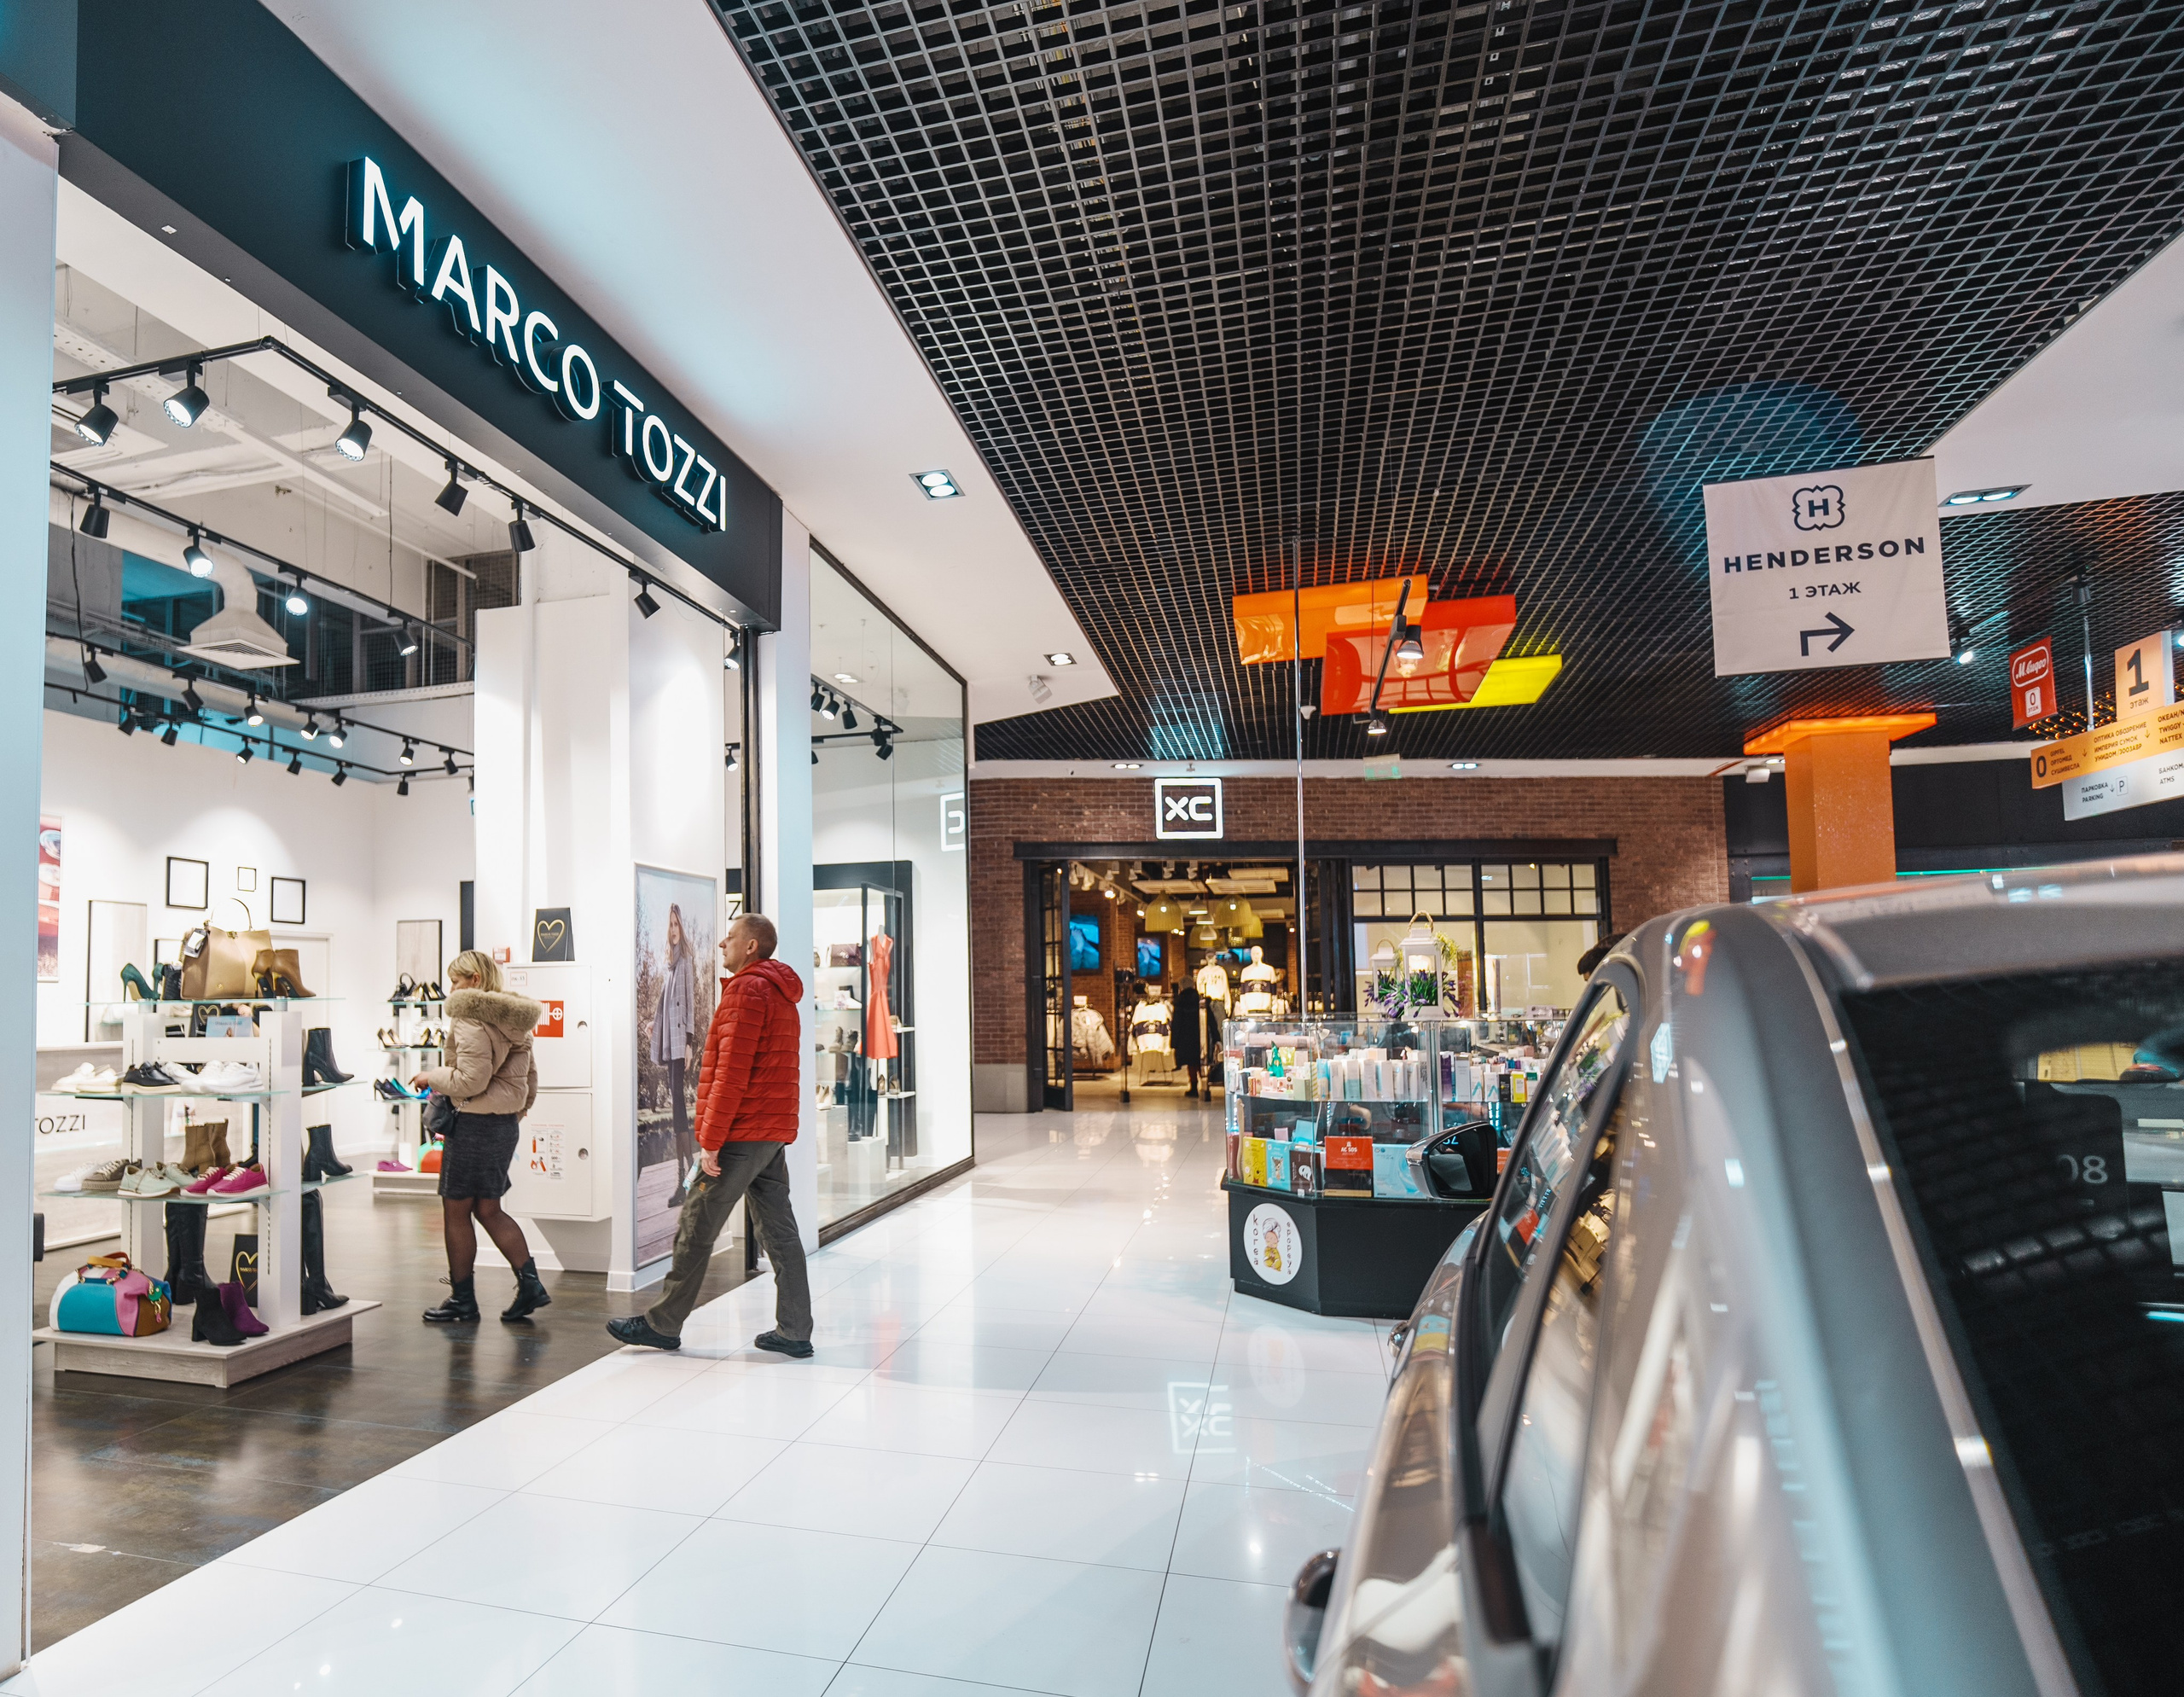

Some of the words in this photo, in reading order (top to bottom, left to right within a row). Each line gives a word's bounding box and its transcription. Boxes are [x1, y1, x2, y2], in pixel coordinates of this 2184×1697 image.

[362, 156, 601, 420] MARCO
[613, 380, 726, 532] TOZZI
[1808, 498, 1830, 517] H
[1724, 537, 1925, 573] HENDERSON
[1789, 587, 1799, 599] 1
[1805, 581, 1862, 598] ЭТАЖ
[2127, 648, 2149, 697] 1
[2030, 692, 2036, 706] 0
[2094, 732, 2114, 743] ОПТИКА
[2116, 722, 2146, 736] ОБОЗРЕНИЕ
[2158, 722, 2181, 734] TWIGGY
[2094, 741, 2118, 753] ИМПЕРИЯ
[2119, 735, 2138, 746] СУМОК
[2159, 733, 2182, 745] NATTEX
[2036, 755, 2047, 778] 0
[2081, 782, 2108, 793] ПАРКОВКА
[2118, 780, 2125, 793] P
[2159, 776, 2175, 785] ATMS
[2082, 793, 2104, 803] PARKING
[34, 1114, 85, 1135] OZZI
